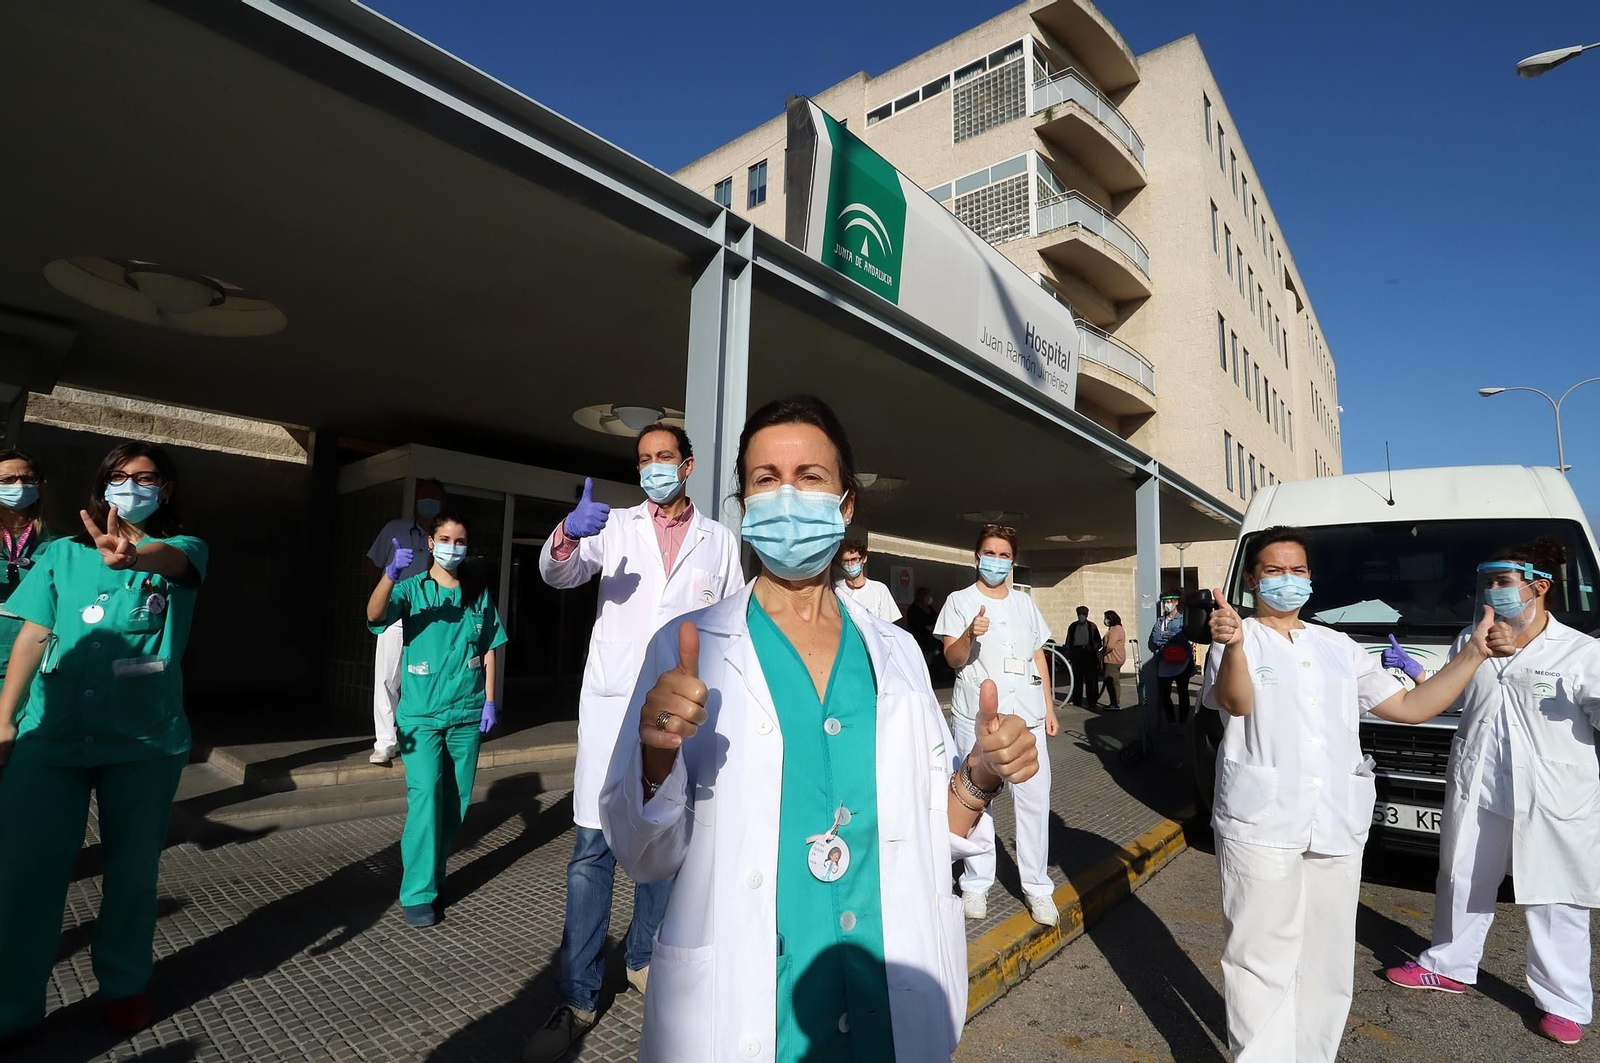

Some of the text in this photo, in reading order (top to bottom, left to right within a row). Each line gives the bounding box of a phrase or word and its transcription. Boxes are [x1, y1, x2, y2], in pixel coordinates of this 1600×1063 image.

[834, 243, 853, 263] JUNTA
[855, 255, 863, 269] DE
[980, 326, 1069, 395] Juan Ramón Jiménez
[1025, 321, 1071, 373] Hospital
